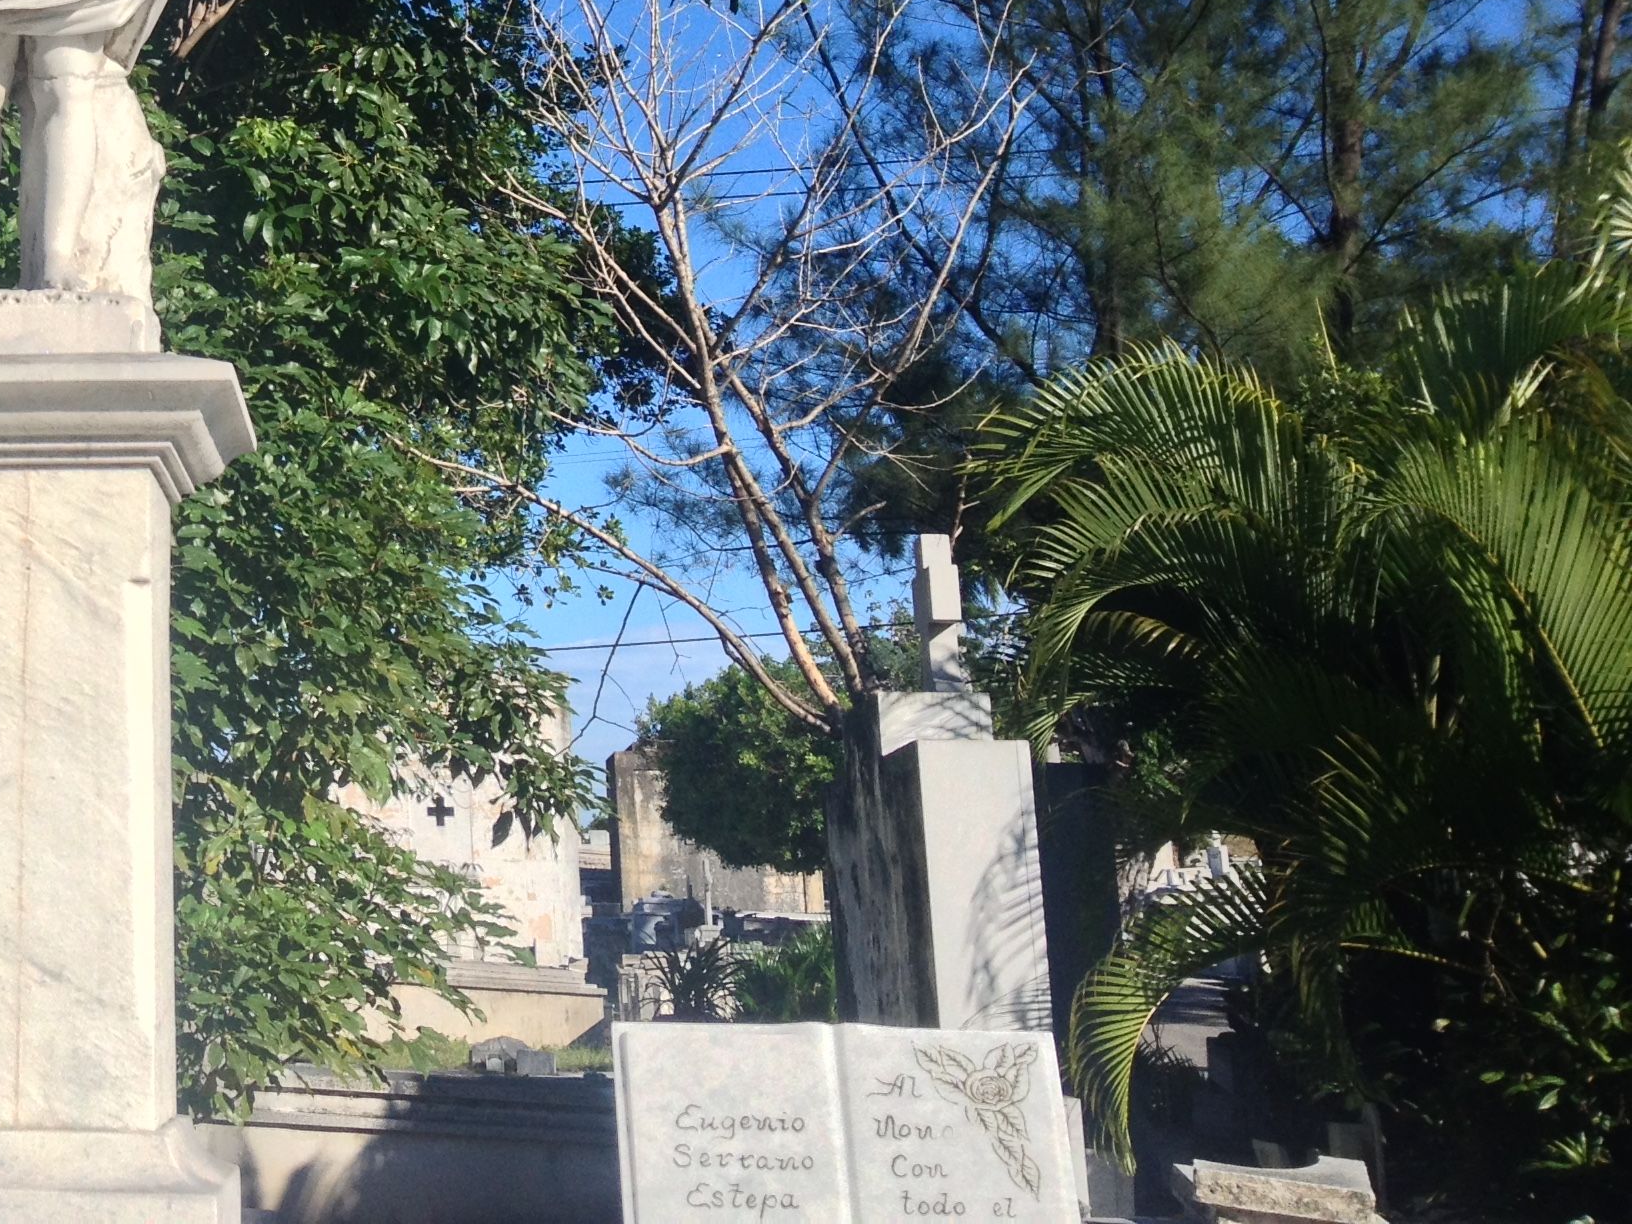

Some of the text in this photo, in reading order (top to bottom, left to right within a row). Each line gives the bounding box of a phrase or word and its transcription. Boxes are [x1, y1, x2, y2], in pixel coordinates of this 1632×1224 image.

[866, 1073, 922, 1098] Al
[675, 1103, 805, 1140] Eugenio
[672, 1143, 814, 1170] Serrano
[891, 1154, 949, 1178] Con
[686, 1182, 800, 1220] Estepa
[900, 1190, 1017, 1218] todo el
